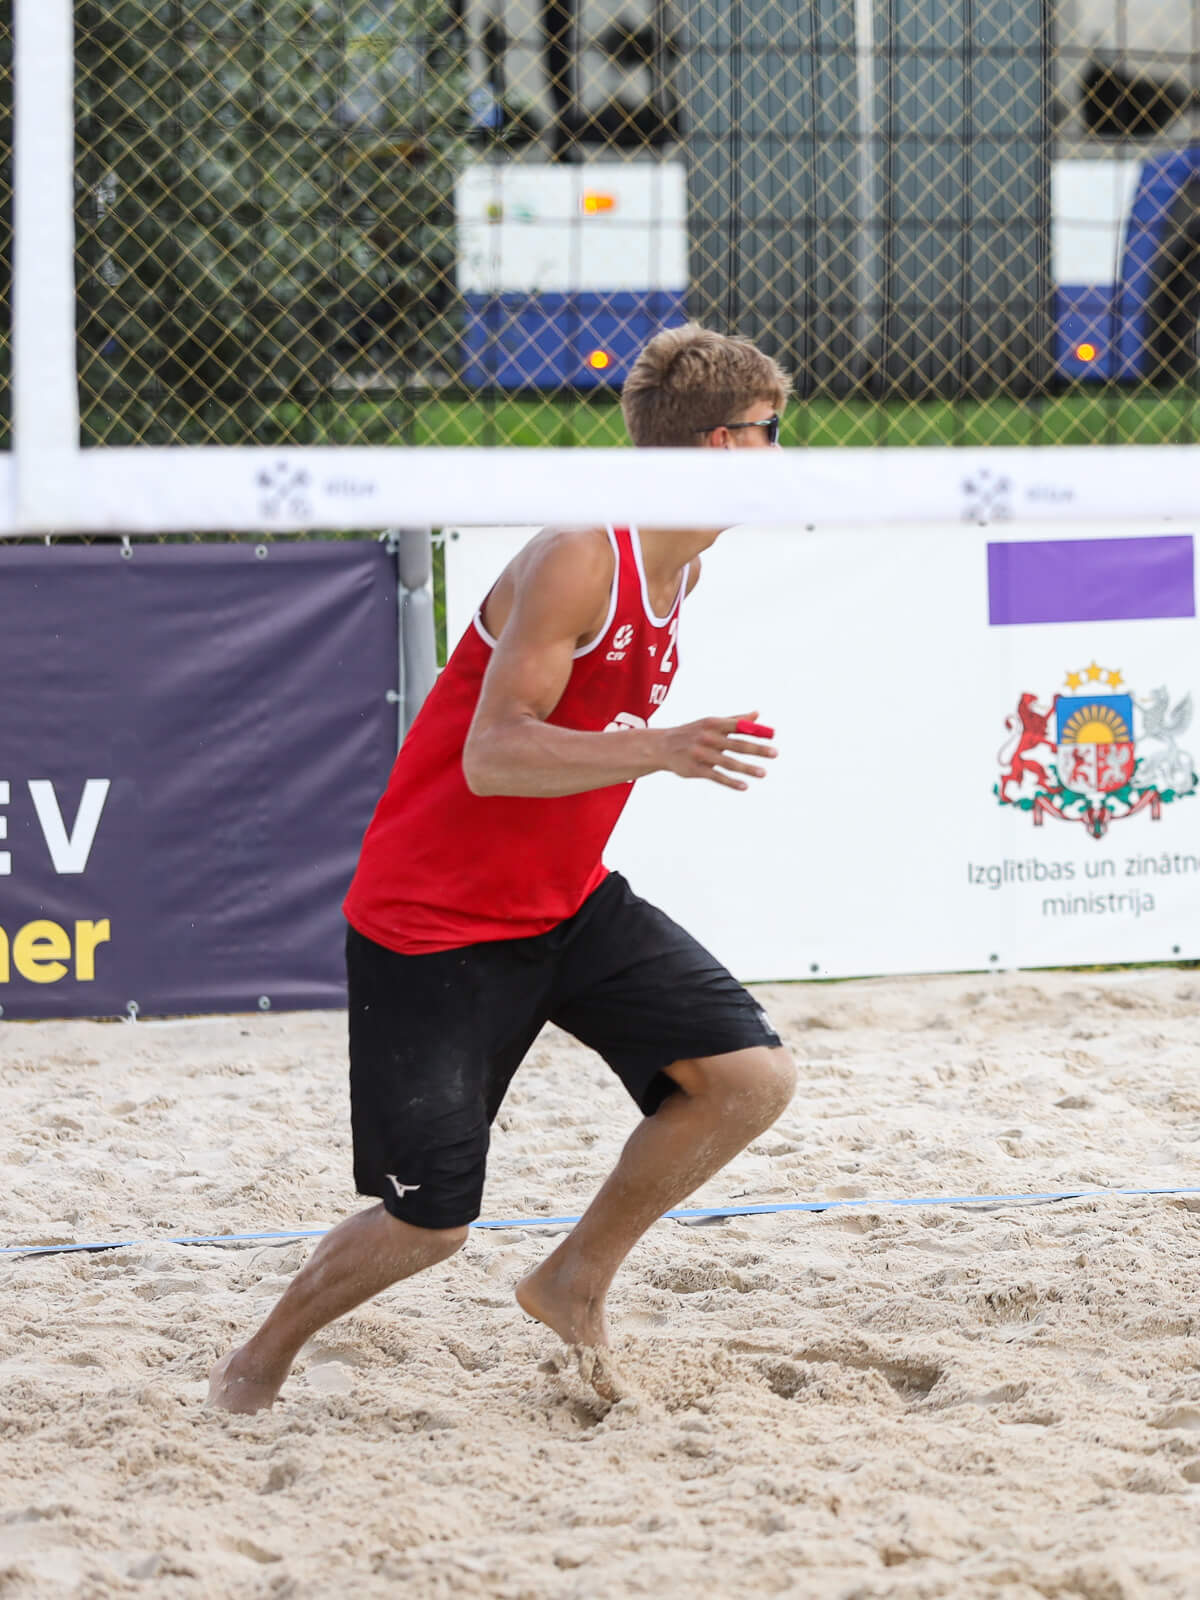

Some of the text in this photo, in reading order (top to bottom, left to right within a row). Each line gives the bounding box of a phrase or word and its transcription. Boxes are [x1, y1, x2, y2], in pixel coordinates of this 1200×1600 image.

[0, 778, 111, 875] V
[967, 857, 1075, 891] Izglītības
[1084, 858, 1116, 880] un
[1042, 891, 1156, 917] ministrija
[0, 918, 111, 983] er
